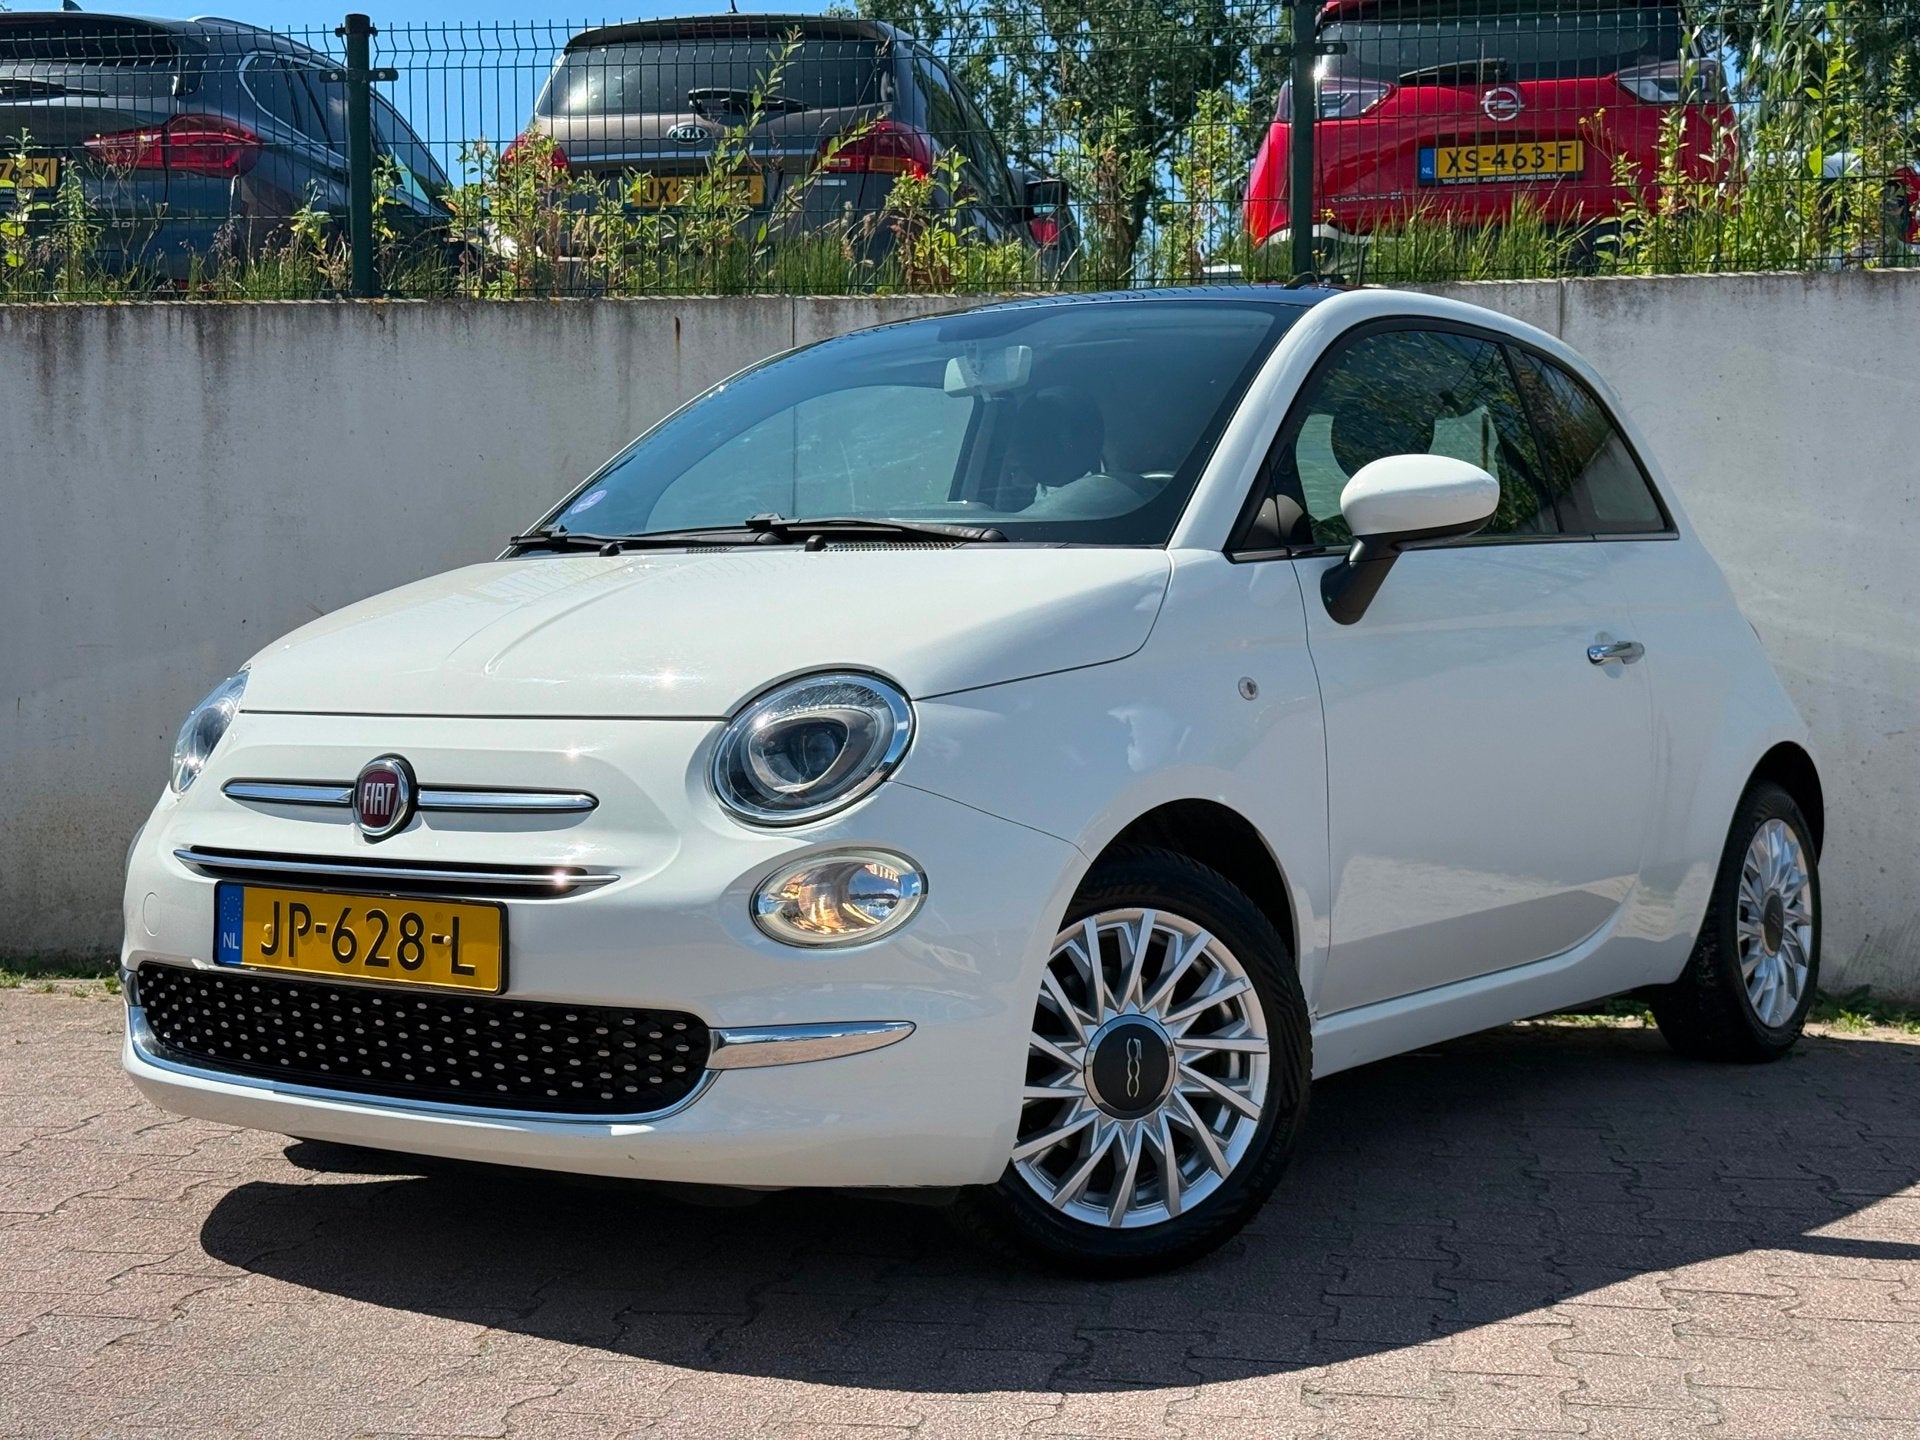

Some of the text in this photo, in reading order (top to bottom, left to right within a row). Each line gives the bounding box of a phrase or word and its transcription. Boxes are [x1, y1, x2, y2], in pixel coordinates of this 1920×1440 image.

[677, 129, 701, 139] KIA
[1421, 167, 1433, 175] NL
[1446, 145, 1572, 174] XS-463-F
[363, 782, 396, 816] FIAT
[222, 931, 240, 950] NL
[260, 900, 477, 977] JP-628-L
